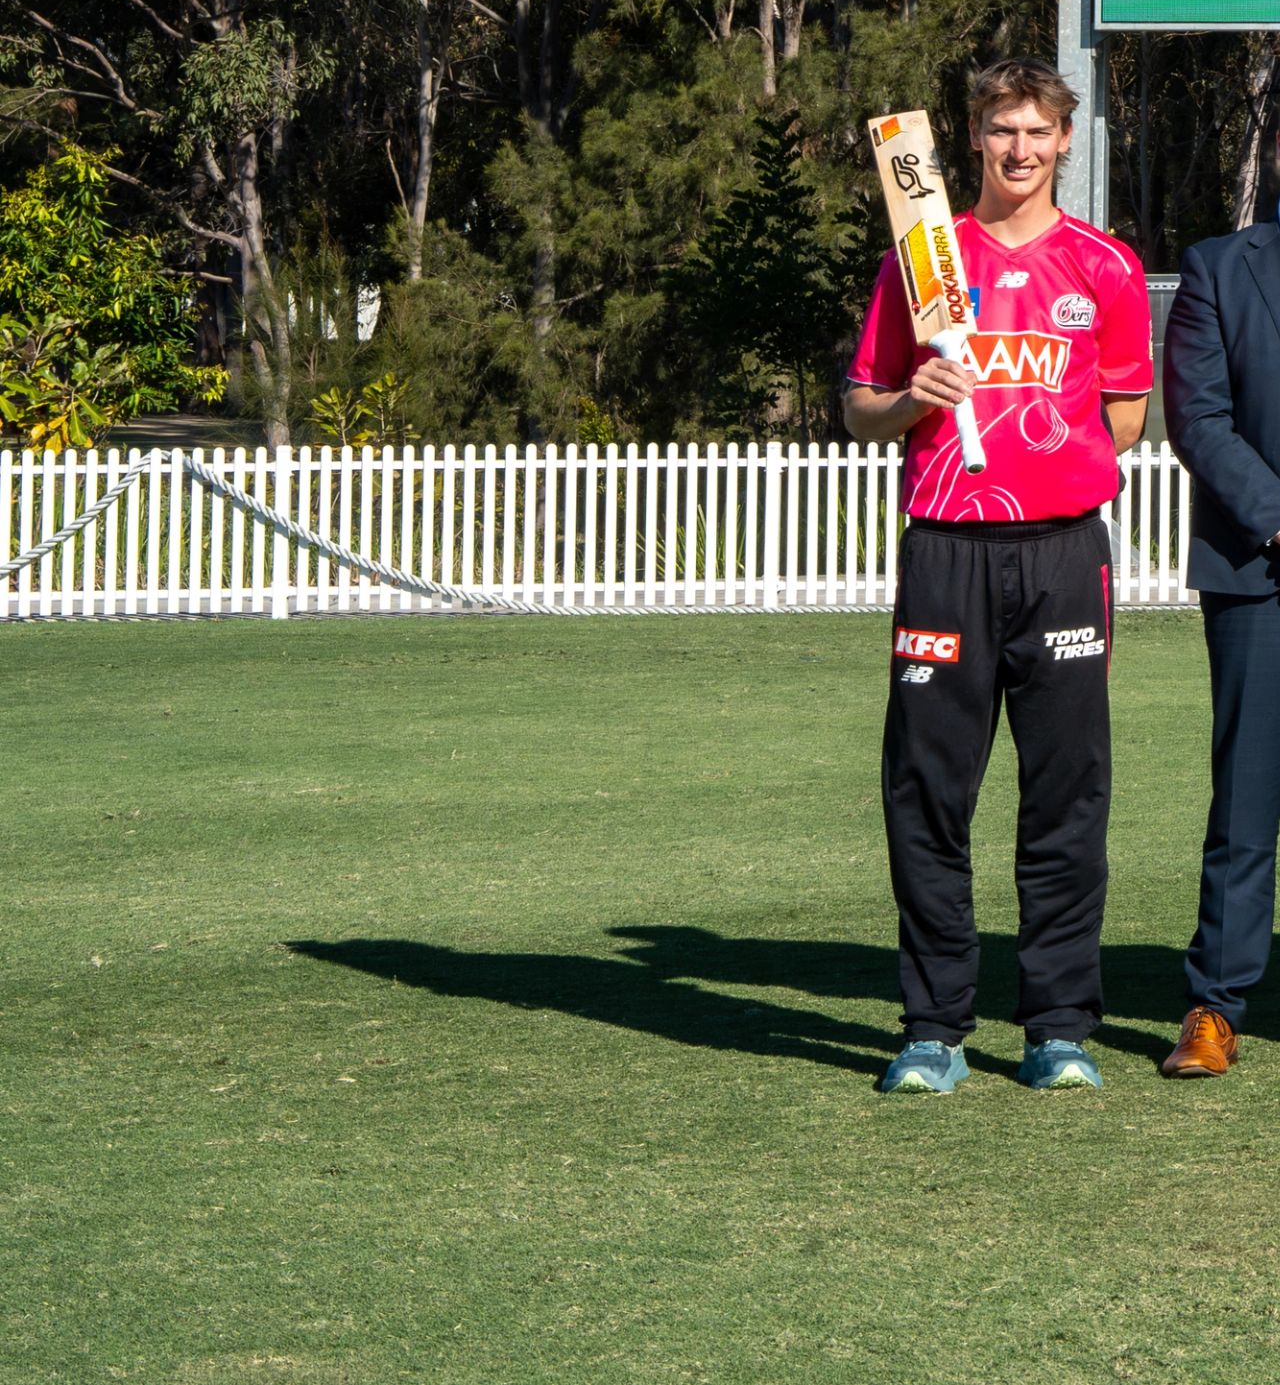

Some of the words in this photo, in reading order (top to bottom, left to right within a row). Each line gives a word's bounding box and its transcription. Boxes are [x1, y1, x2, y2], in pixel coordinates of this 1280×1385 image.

[931, 225, 967, 324] KOOKABURRA
[895, 630, 957, 659] KFC
[1044, 627, 1096, 647] TOYO
[1054, 639, 1106, 661] TIRES
